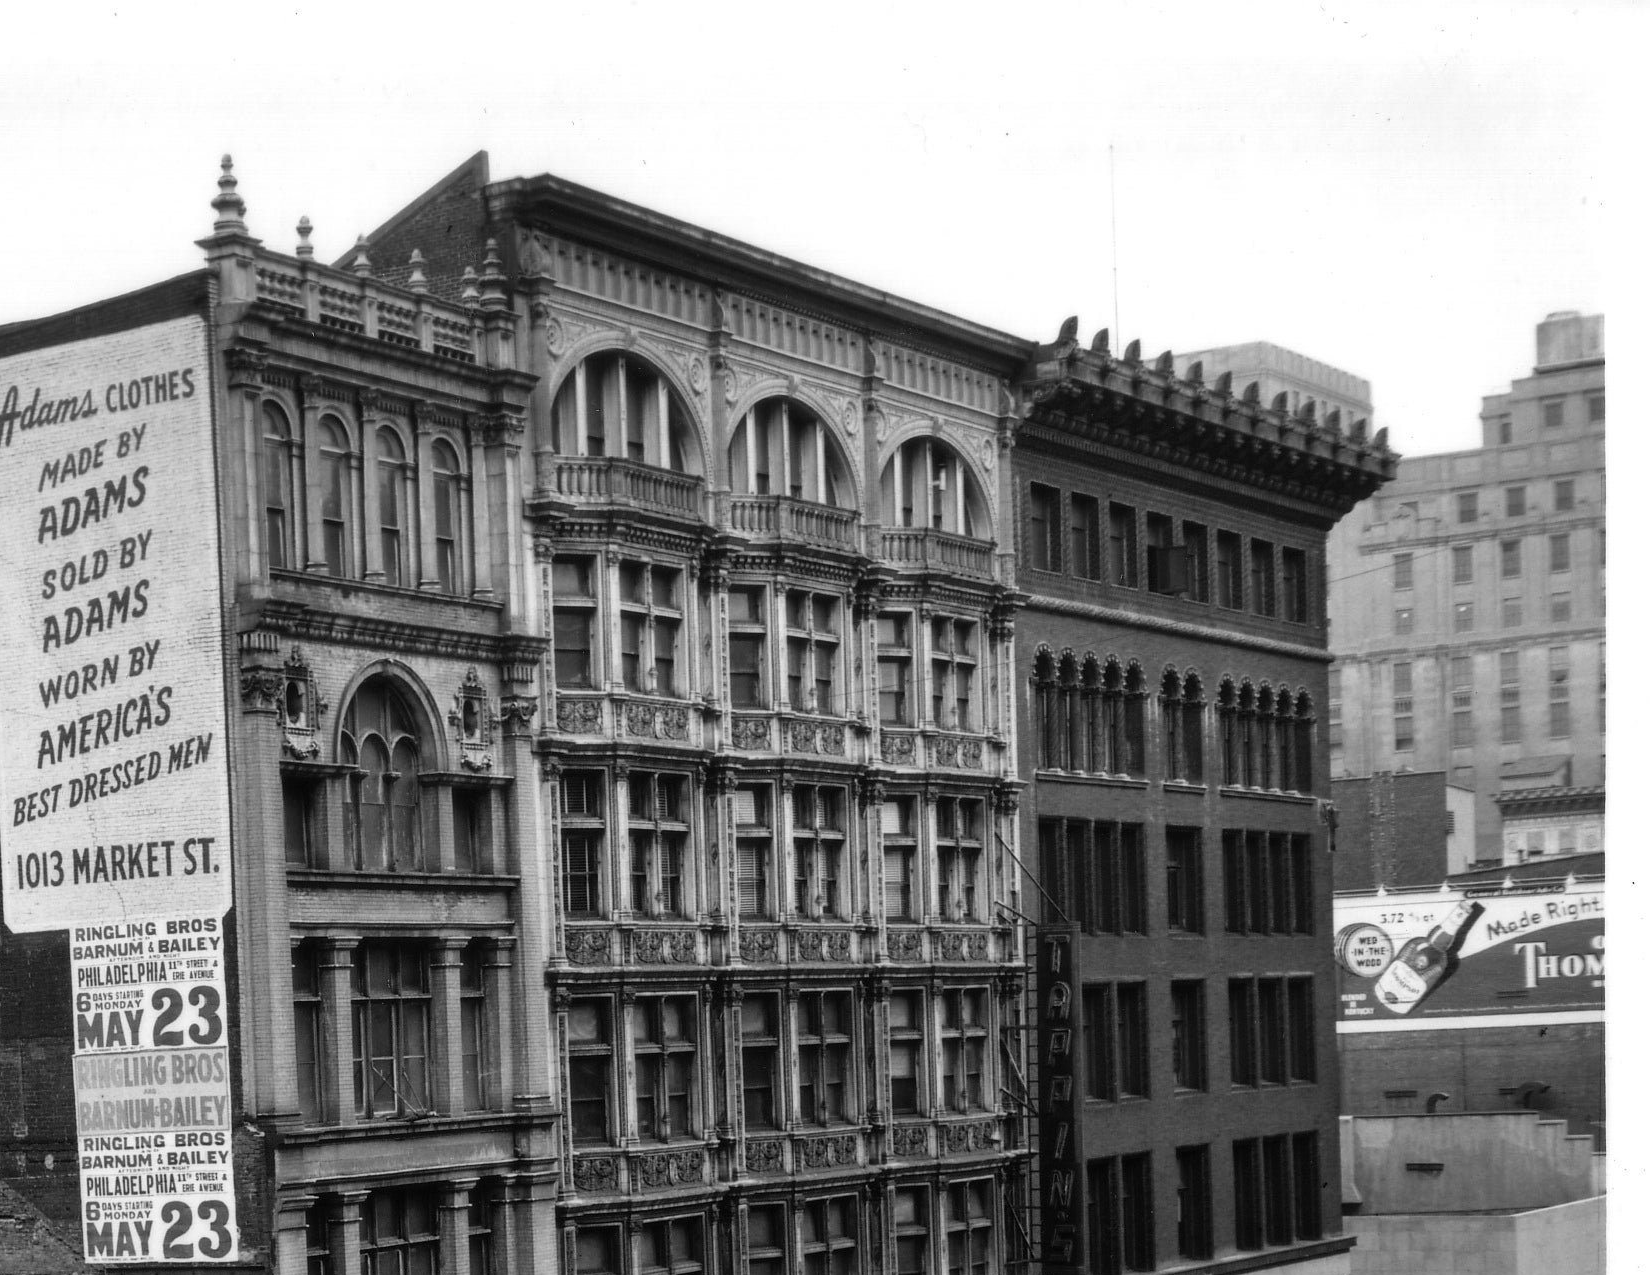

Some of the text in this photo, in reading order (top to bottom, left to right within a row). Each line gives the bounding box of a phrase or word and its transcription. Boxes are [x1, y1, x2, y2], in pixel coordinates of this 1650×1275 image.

[106, 369, 195, 413] CLOTHES
[38, 423, 147, 493] MADE BY
[38, 466, 149, 544] ADAMS
[42, 530, 152, 599] SOLD BY
[42, 579, 150, 654] ADAMS
[39, 640, 160, 709] WORN BY
[37, 686, 173, 769] AMERICA'S
[13, 732, 213, 826] BEST DRESSED MEN
[16, 837, 220, 889] 1013 MARKET ST.
[75, 918, 217, 942] RINGLING BROS
[1486, 910, 1542, 941] Made
[73, 936, 220, 960] BARNUM & BAILEY
[78, 961, 167, 988] PHILADELPHIA
[186, 959, 210, 969] STREET
[1357, 958, 1382, 967] WOOD
[172, 970, 214, 980] ERIE AVENUE
[76, 992, 92, 1012] 6
[93, 989, 144, 1002] DAYS STARTING
[95, 999, 142, 1011] MONDAY
[77, 985, 223, 1049] MAY 23
[77, 1052, 224, 1089] RINGLING BROS
[79, 1098, 155, 1131] BARNUM
[160, 1095, 227, 1128] BAILEY
[83, 1132, 225, 1151] RINGLING BROS
[81, 1150, 229, 1170] BARNUM & BAILEY
[87, 1173, 177, 1197] PHILADELPHIA
[182, 1183, 224, 1192] ERIE AVENUE
[195, 1172, 218, 1181] STREET
[86, 1201, 101, 1221] 6
[102, 1201, 153, 1211] DAYS STARTING
[104, 1211, 151, 1220] MONDAY
[86, 1200, 232, 1259] MAY 23
